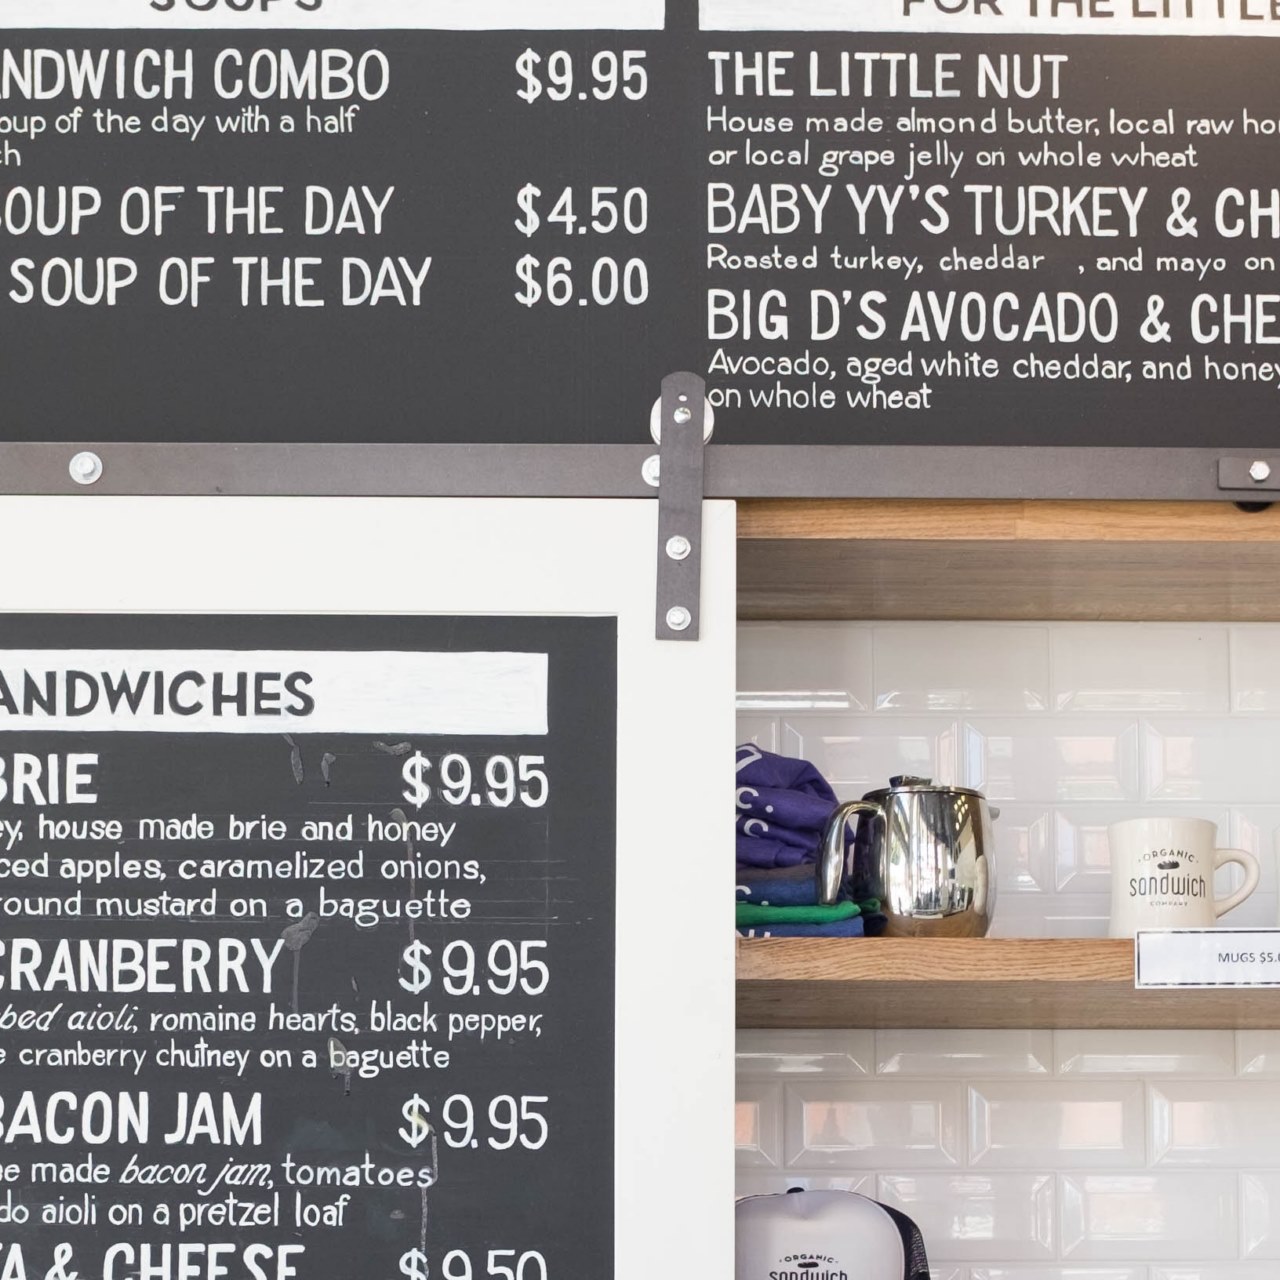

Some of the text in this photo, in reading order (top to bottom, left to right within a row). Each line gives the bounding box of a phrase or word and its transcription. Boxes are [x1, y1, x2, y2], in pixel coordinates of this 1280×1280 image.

[214, 49, 389, 100] COMBO
[516, 48, 647, 104] $9.95
[708, 51, 794, 96] THE
[810, 51, 961, 97] LITTLE
[978, 54, 1068, 98] NUT
[121, 186, 184, 236] OF
[197, 186, 283, 234] THE
[305, 186, 394, 234] DAY
[515, 183, 647, 237] $4.50
[708, 183, 832, 234] BABY
[846, 184, 949, 234] YY'S
[964, 185, 1147, 237] TURKEY
[1166, 187, 1198, 237] &
[708, 289, 788, 340] BIG
[811, 290, 887, 340] D'S
[901, 291, 1118, 343] AVOCADO
[1140, 295, 1171, 343] &
[403, 751, 548, 808] $9.95
[60, 852, 166, 883] apples,
[179, 850, 363, 879] caramelized
[381, 852, 486, 884] onions,
[1144, 848, 1195, 863] ORGANIC
[1130, 873, 1206, 898] sandwich
[399, 939, 549, 995] $9.95
[1218, 952, 1256, 963] MUGS
[19, 1041, 146, 1075] cranberry
[156, 1037, 249, 1076] chutney
[260, 1050, 291, 1067] on
[302, 1050, 316, 1067] a
[330, 1040, 449, 1078] baguette
[165, 1092, 261, 1145] JAM
[399, 1093, 548, 1150] $9.95
[785, 1254, 834, 1263] ORGANIC
